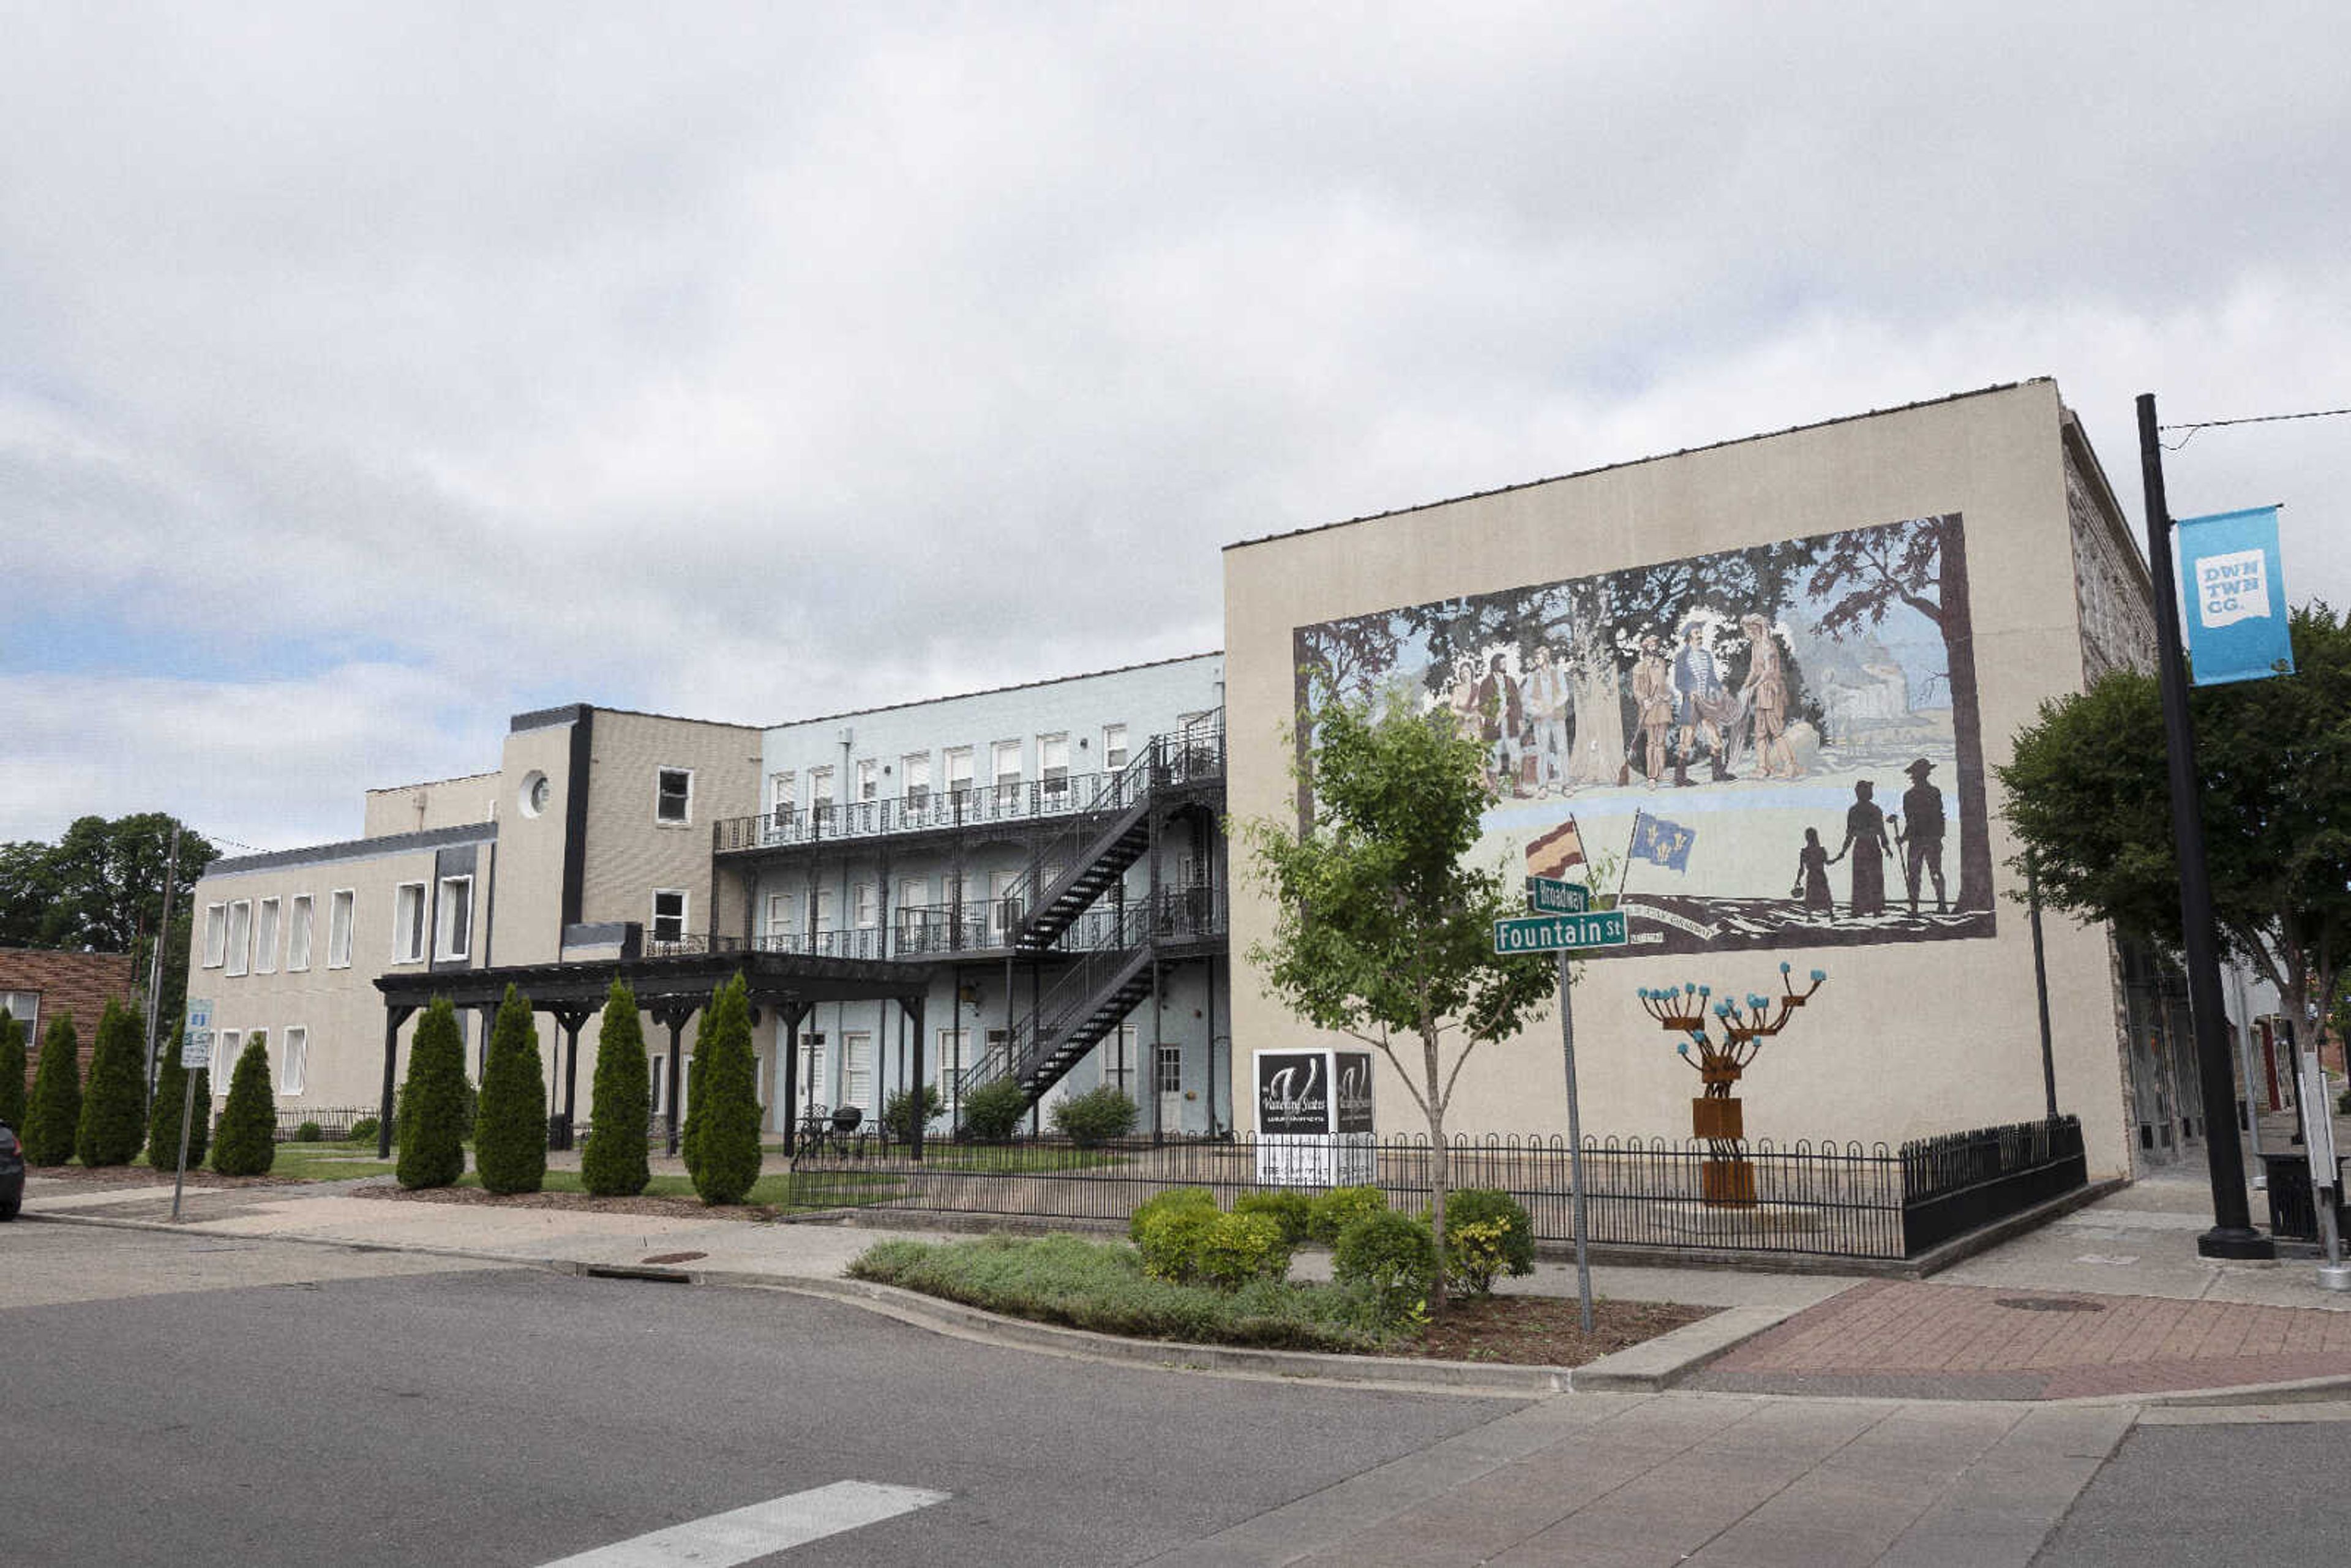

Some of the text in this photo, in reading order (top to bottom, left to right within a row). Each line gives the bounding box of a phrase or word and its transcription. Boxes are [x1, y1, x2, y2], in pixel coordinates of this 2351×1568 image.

[1539, 880, 1584, 912] Broadway
[1500, 918, 1602, 949] Fountain
[1606, 920, 1621, 937] St
